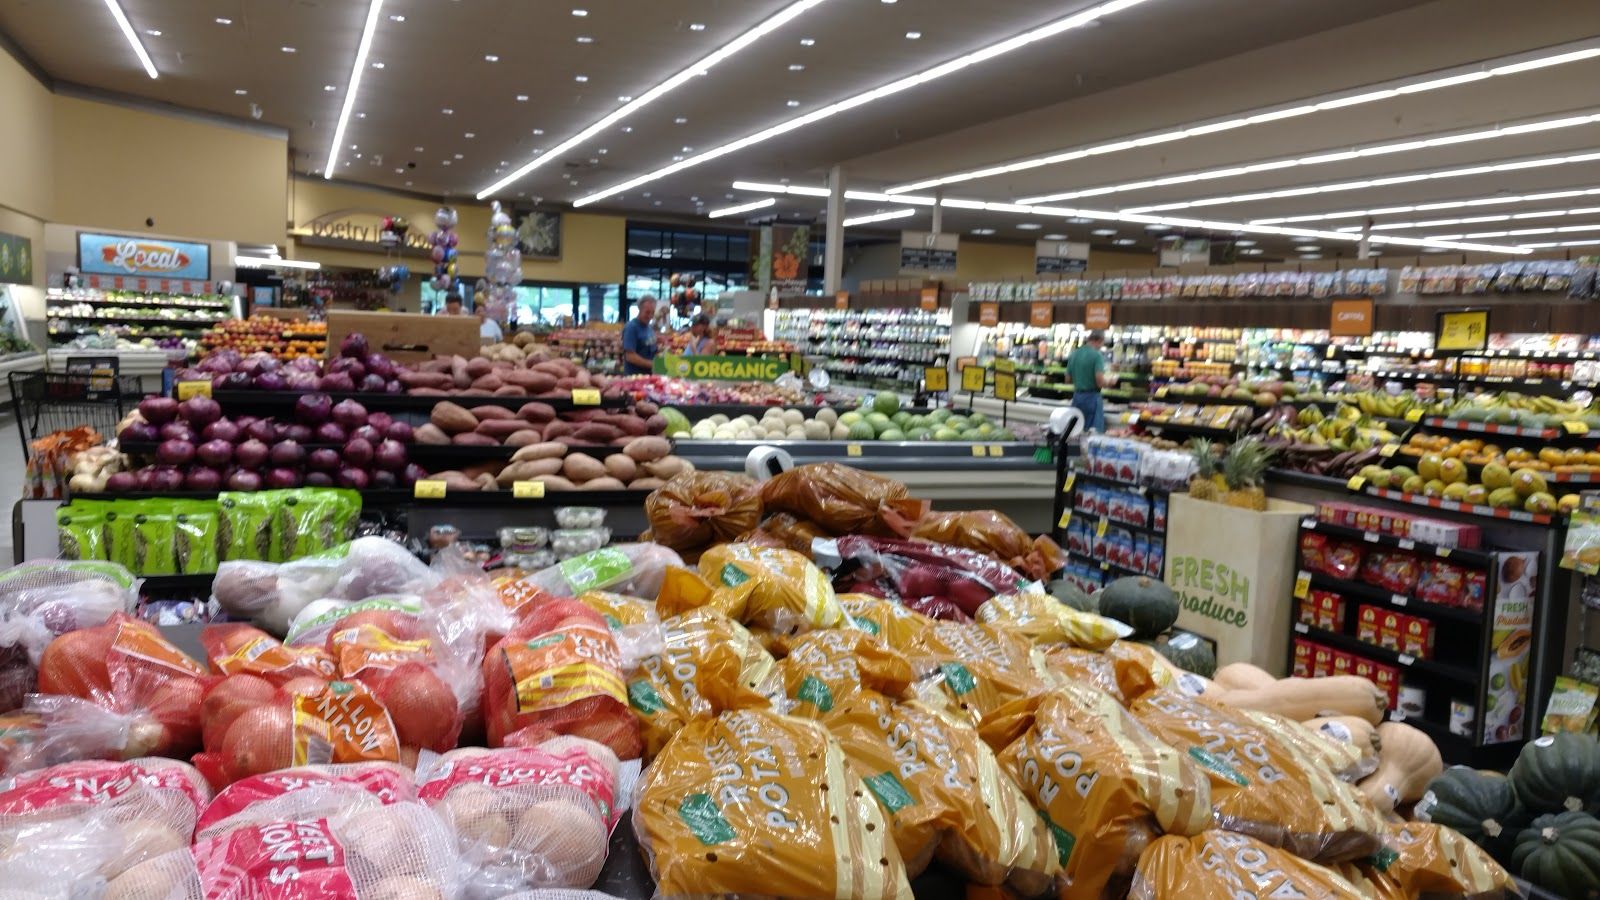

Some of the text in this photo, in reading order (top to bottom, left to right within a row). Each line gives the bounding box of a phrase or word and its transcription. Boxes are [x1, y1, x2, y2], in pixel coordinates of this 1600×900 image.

[312, 220, 368, 240] poetry
[113, 240, 184, 273] Local
[693, 360, 778, 379] ORGANIC
[1170, 556, 1249, 609] FRESH
[1501, 602, 1528, 612] FRESH
